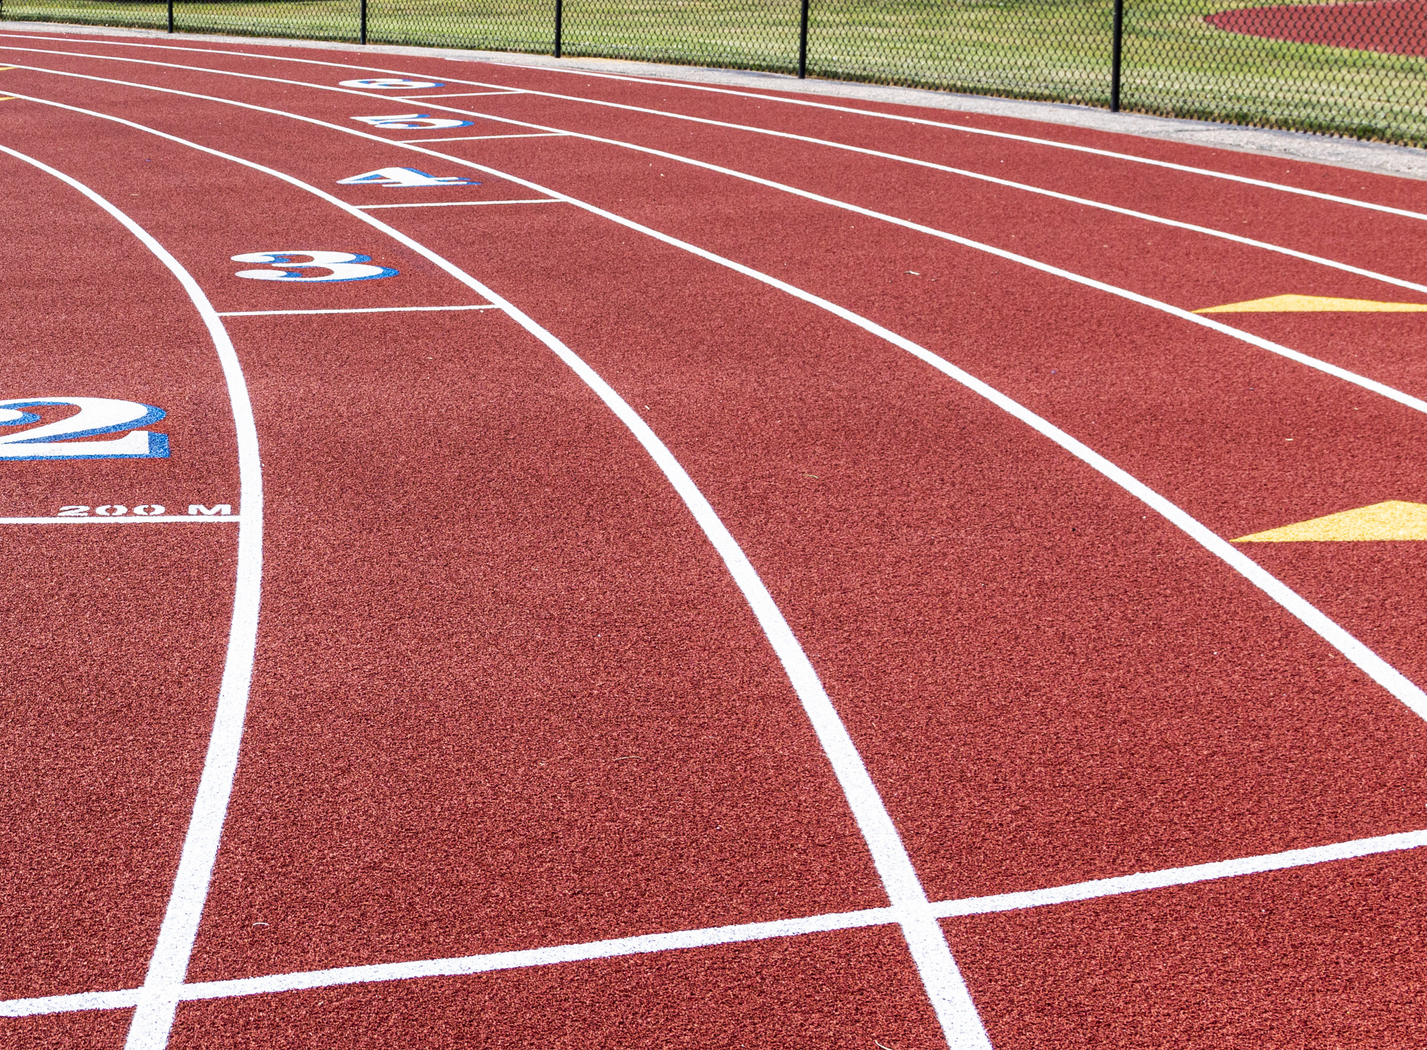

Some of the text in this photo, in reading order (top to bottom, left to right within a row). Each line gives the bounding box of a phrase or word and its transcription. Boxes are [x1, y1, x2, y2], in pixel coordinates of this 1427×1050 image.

[338, 78, 446, 89] 6
[350, 113, 475, 129] 5
[336, 167, 483, 187] 4
[230, 250, 400, 283] 3
[57, 504, 232, 518] 200 M
